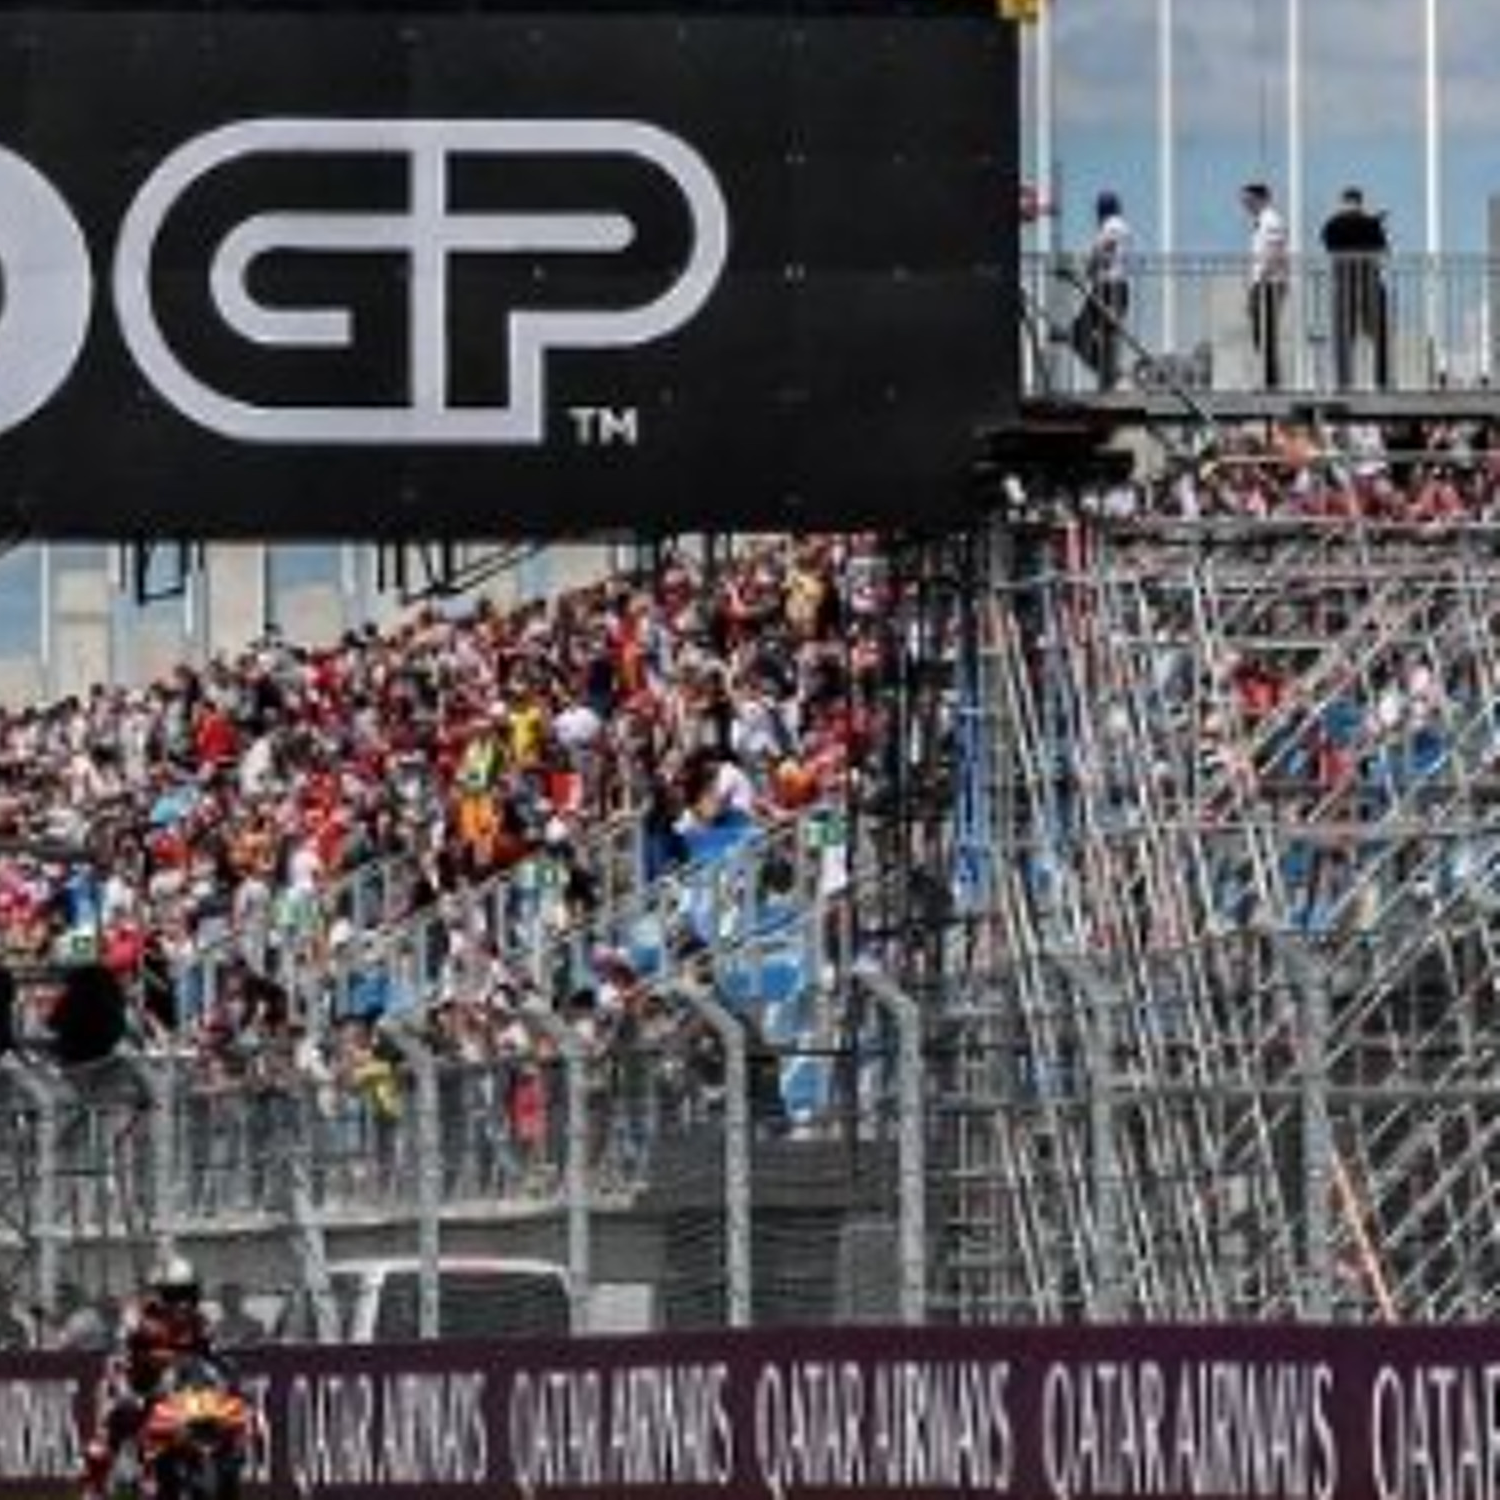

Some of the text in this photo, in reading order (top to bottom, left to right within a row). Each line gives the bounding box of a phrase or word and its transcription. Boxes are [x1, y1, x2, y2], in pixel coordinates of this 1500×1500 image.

[568, 406, 638, 445] TM
[755, 1361, 865, 1500] QATAR
[1042, 1360, 1338, 1500] QATAR AIRWAYS
